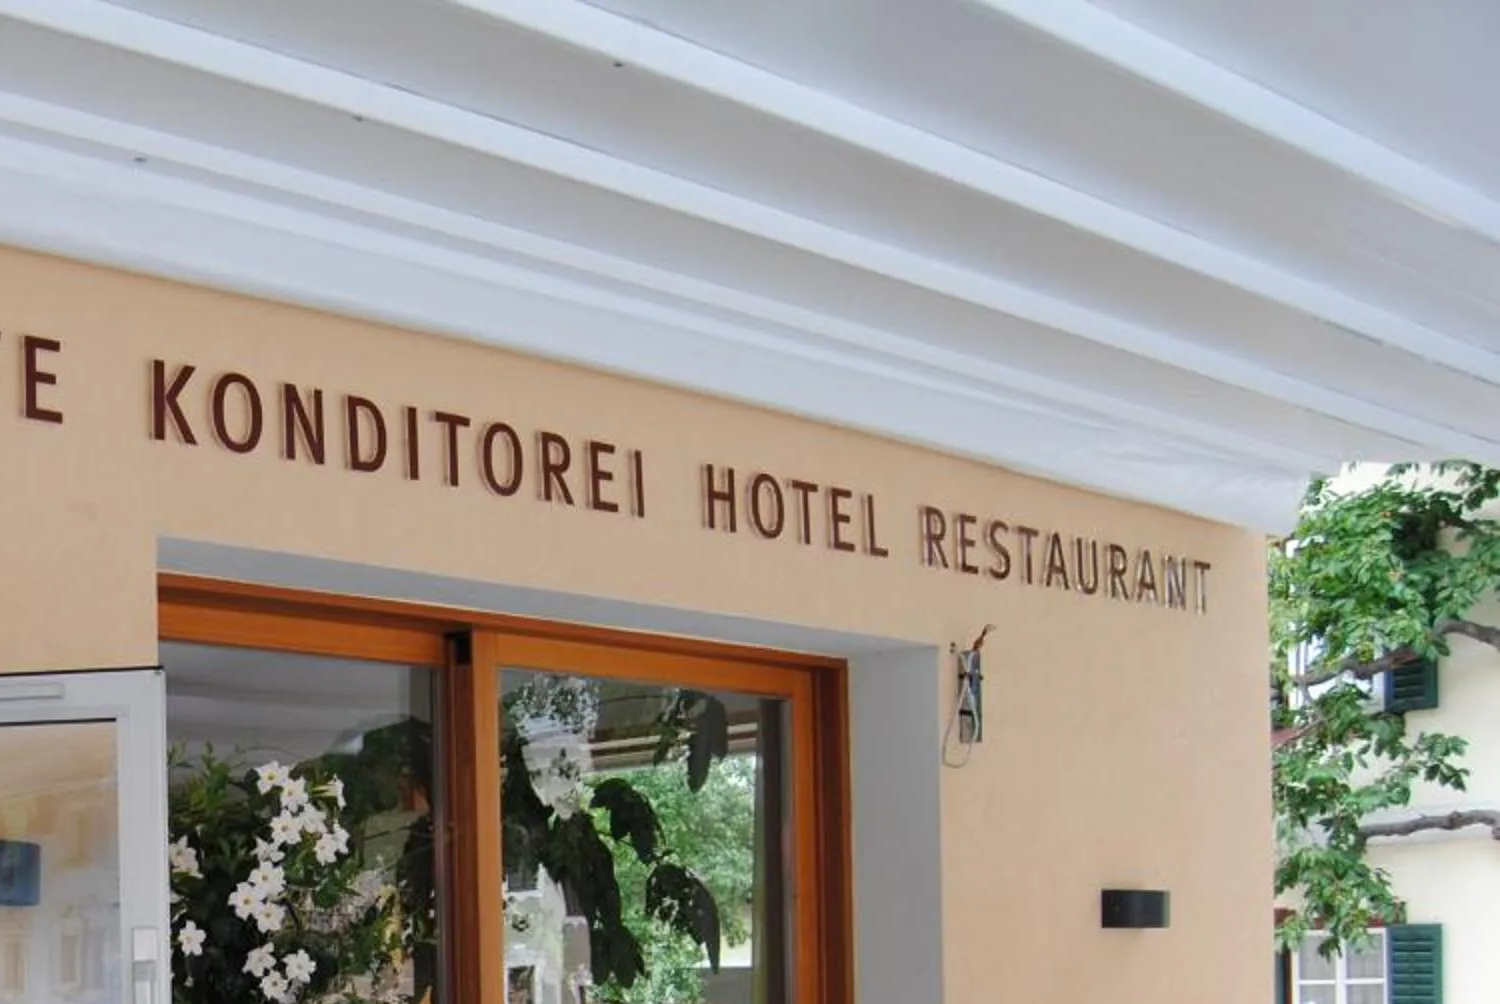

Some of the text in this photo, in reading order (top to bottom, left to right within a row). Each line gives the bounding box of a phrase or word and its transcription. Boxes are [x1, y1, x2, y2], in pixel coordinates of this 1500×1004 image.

[151, 358, 645, 518] KONDITOREI
[701, 462, 889, 558] HOTEL
[919, 505, 1212, 613] RESTAURANT
